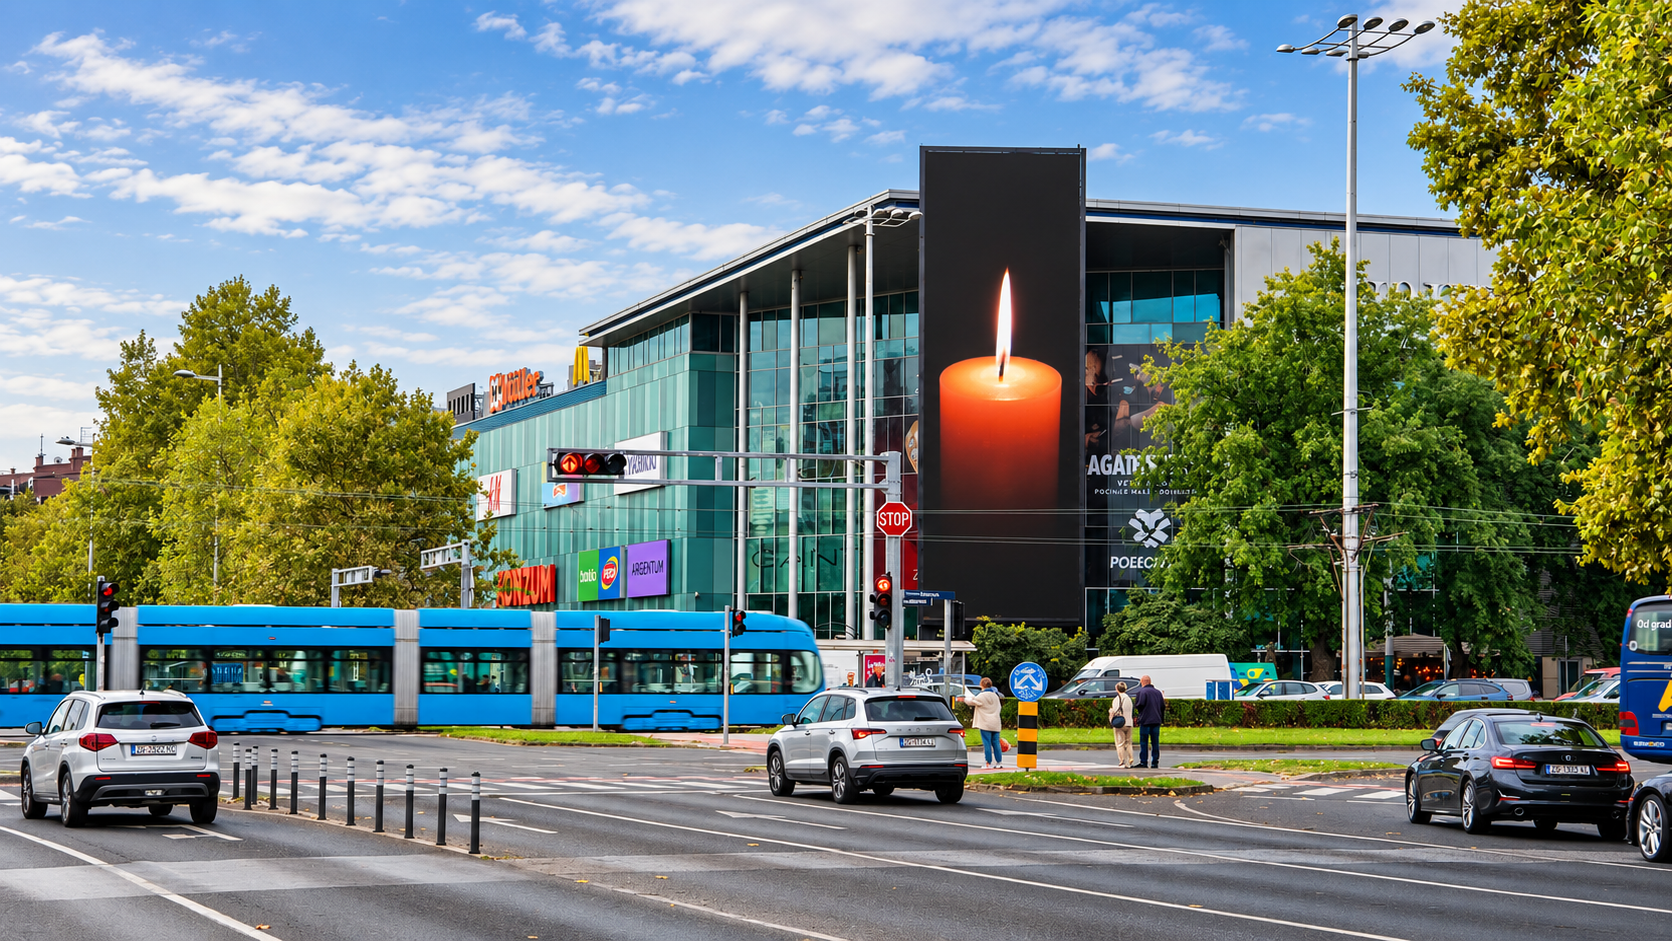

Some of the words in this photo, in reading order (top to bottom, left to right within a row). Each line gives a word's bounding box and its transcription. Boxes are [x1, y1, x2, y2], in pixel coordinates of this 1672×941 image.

[880, 512, 909, 526] STOP
[631, 559, 664, 576] ARGENTUM
[496, 563, 555, 608] KONZUM
[1637, 619, 1650, 628] Od
